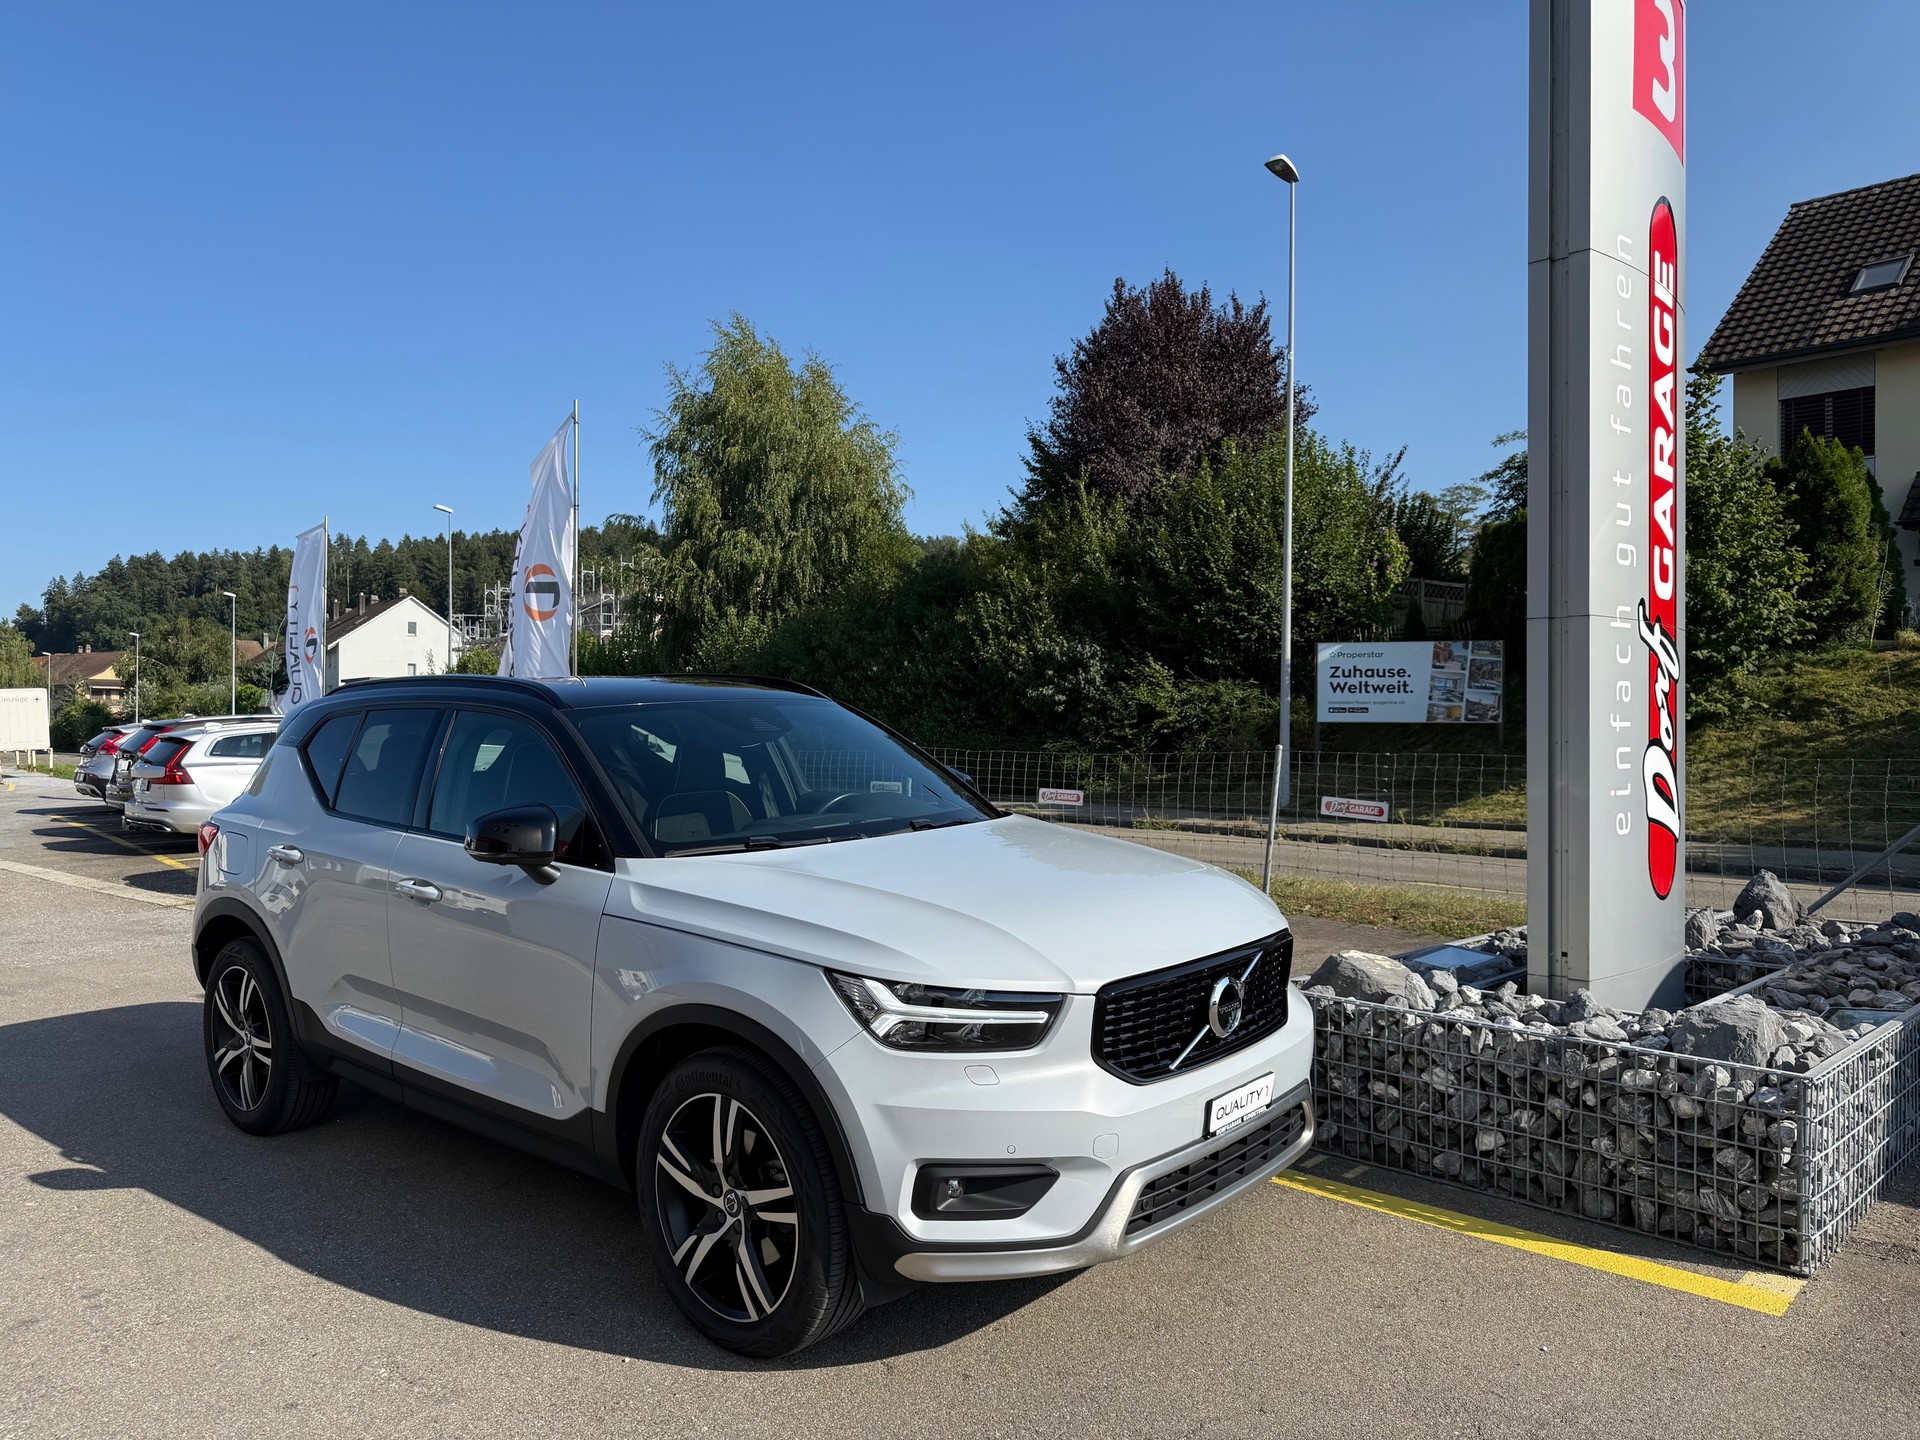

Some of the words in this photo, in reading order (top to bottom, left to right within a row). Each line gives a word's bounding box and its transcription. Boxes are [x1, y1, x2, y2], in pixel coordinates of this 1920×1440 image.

[1611, 233, 1632, 435] fahren
[1653, 249, 1674, 601] GARAGE
[1613, 470, 1637, 567] gut
[1337, 651, 1384, 659] Properstar
[1329, 665, 1411, 679] Zuhause.
[1329, 681, 1414, 694] Weltweit.
[1610, 605, 1632, 836] einfach
[1637, 597, 1680, 843] Dorf
[1349, 804, 1380, 815] GARAGE
[675, 1069, 733, 1092] Continental
[1216, 1087, 1263, 1120] QUALITY
